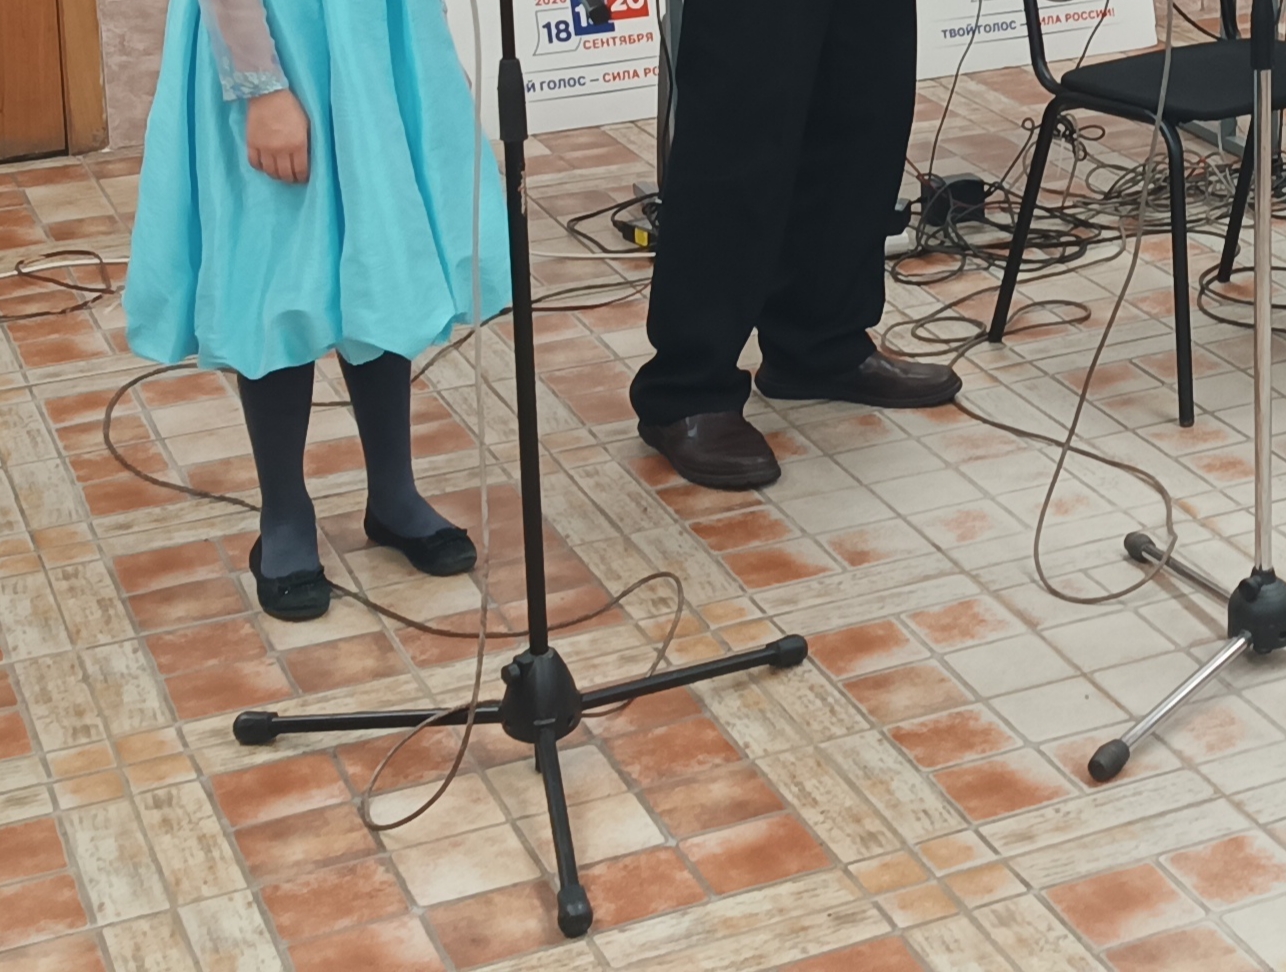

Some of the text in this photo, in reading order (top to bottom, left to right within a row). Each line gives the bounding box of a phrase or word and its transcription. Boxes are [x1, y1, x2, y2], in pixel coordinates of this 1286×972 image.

[542, 20, 572, 44] 18
[941, 23, 975, 39] ТВОЙ
[976, 20, 1017, 34] ГОЛОС
[583, 32, 654, 50] СЕНТЯБРЯ
[540, 75, 586, 91] ГОЛОС
[602, 69, 640, 83] СИЛА
